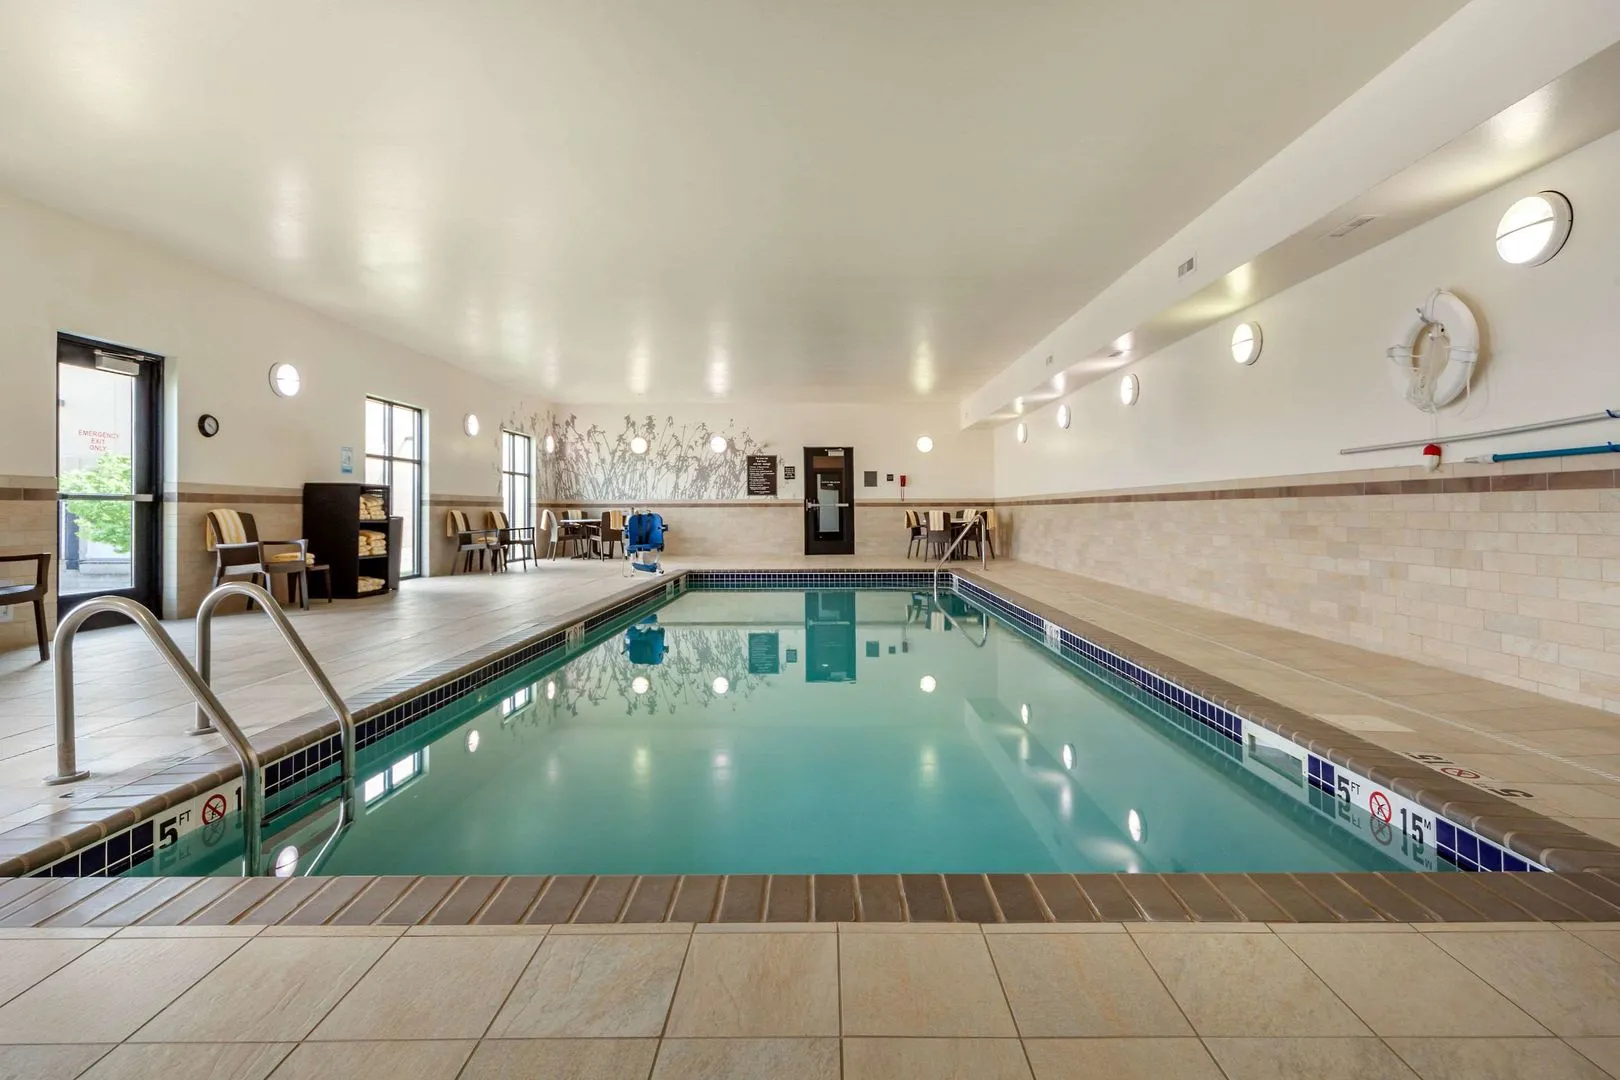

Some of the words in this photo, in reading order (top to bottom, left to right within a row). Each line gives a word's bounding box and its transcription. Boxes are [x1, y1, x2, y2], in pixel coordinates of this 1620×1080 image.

[78, 430, 119, 439] EMERGENCY
[1337, 774, 1351, 803] 5
[1351, 782, 1361, 795] FT
[1424, 819, 1432, 831] M
[159, 816, 179, 850] 5
[179, 809, 192, 826] FT
